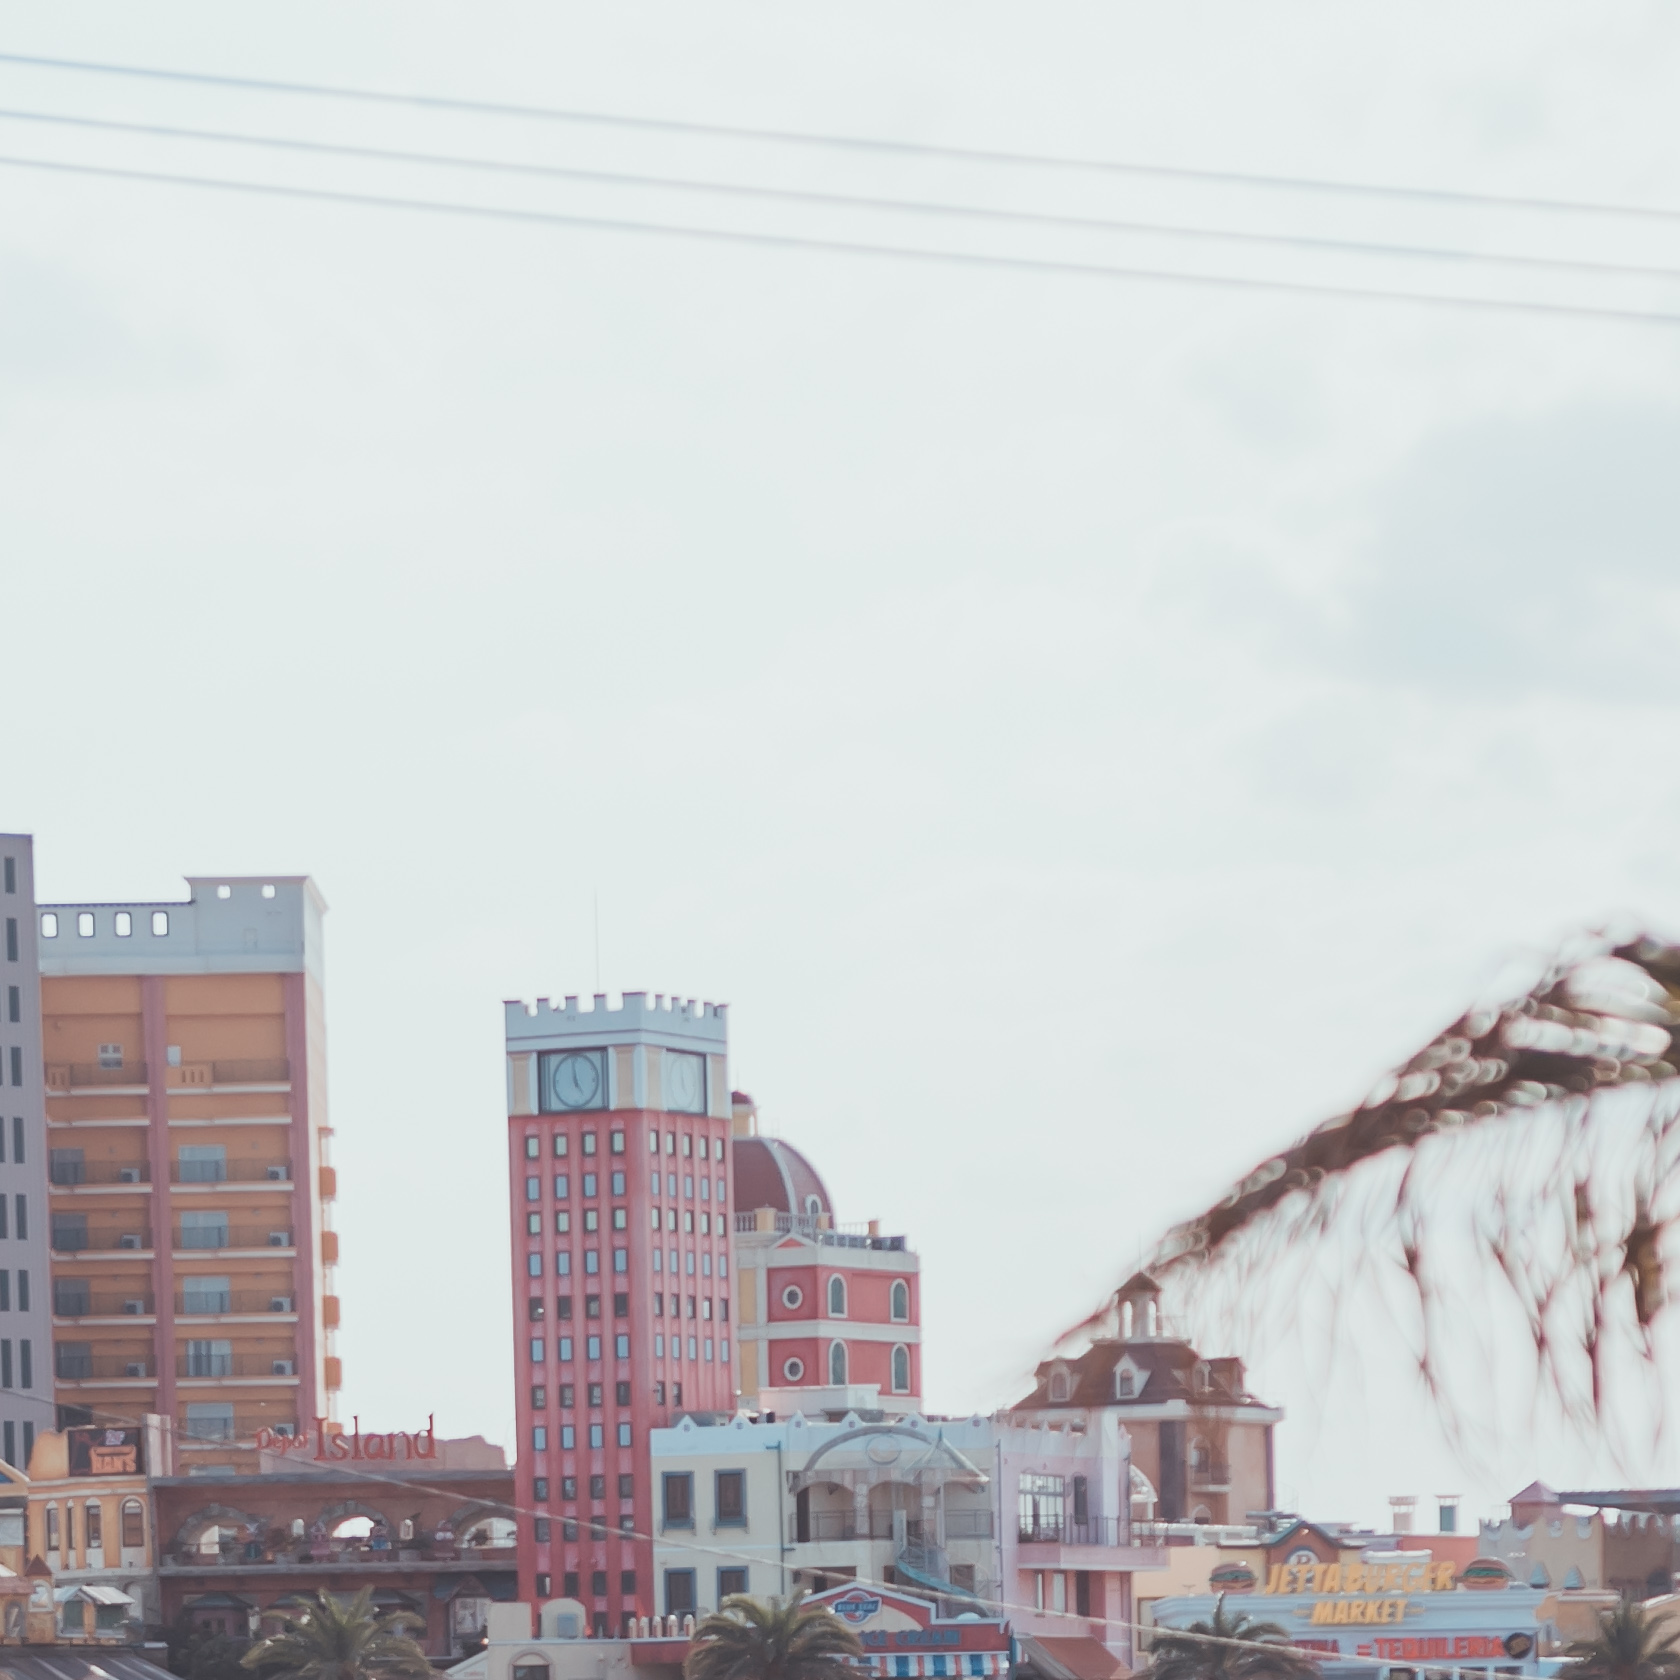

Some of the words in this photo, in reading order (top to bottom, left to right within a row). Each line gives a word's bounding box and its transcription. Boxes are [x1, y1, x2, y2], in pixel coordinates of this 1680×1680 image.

[255, 1427, 310, 1455] Depot
[313, 1412, 437, 1462] Island
[1266, 1563, 1342, 1595] JETTA
[1345, 1560, 1457, 1593] BURGER
[1310, 1600, 1408, 1625] MARKET
[896, 1629, 961, 1646] CREAM
